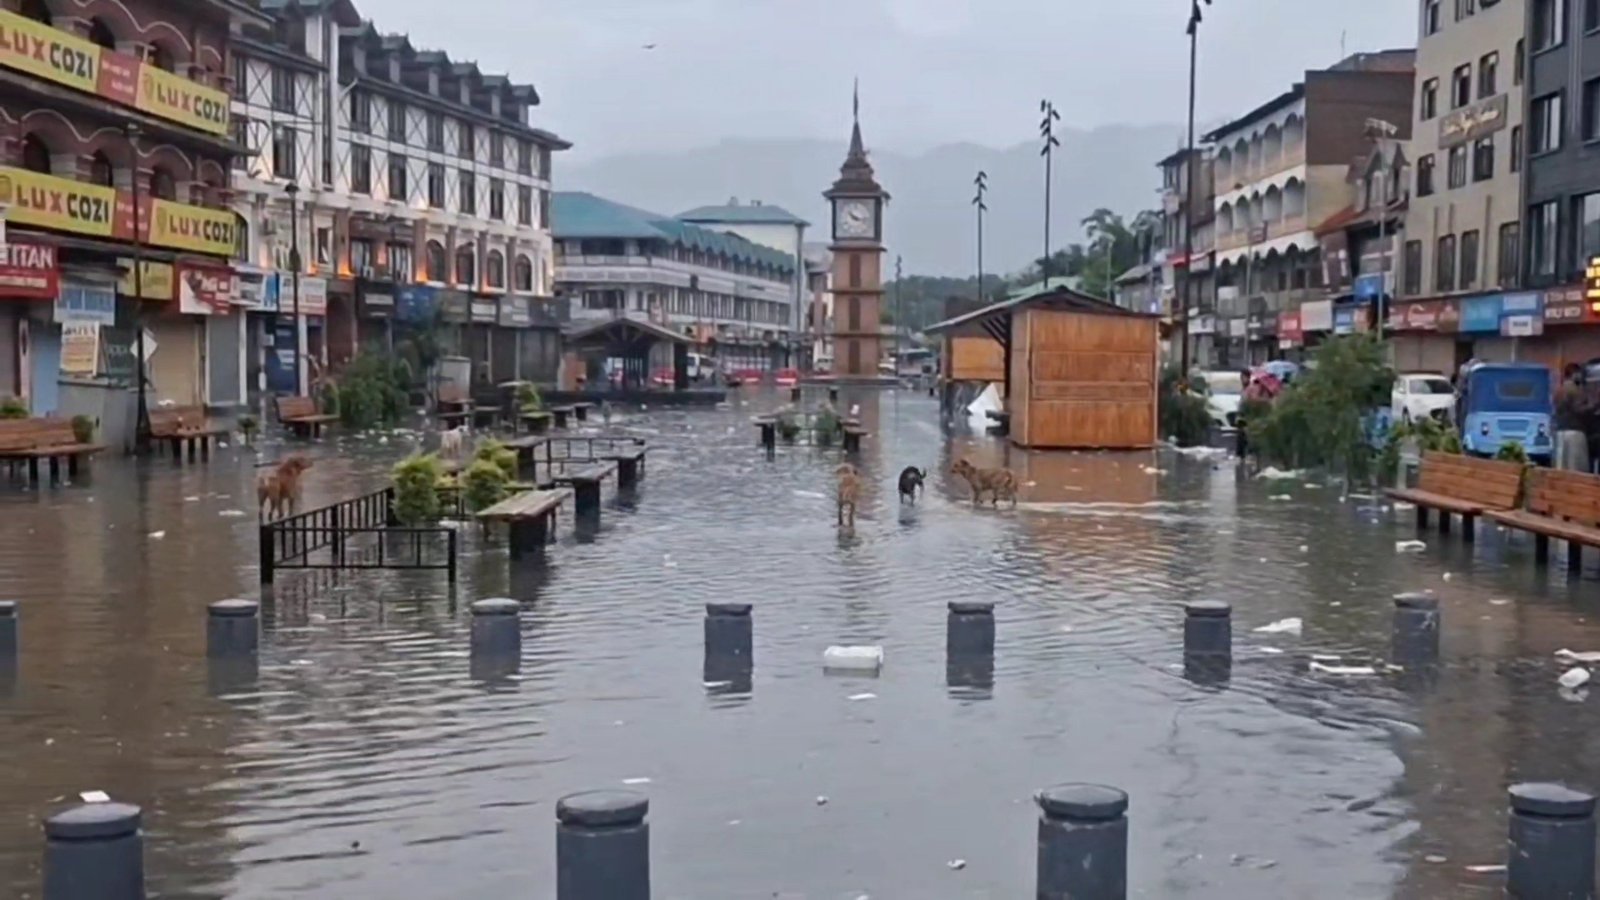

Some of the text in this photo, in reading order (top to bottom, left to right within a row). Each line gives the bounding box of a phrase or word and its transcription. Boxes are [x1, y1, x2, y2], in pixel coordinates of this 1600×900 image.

[0, 26, 45, 60] LUX
[49, 43, 93, 77] COZI
[157, 82, 191, 112] LUX
[193, 95, 227, 124] COZI
[16, 184, 109, 224] LUX COZI
[169, 214, 201, 237] LUX
[203, 219, 234, 243] COZI
